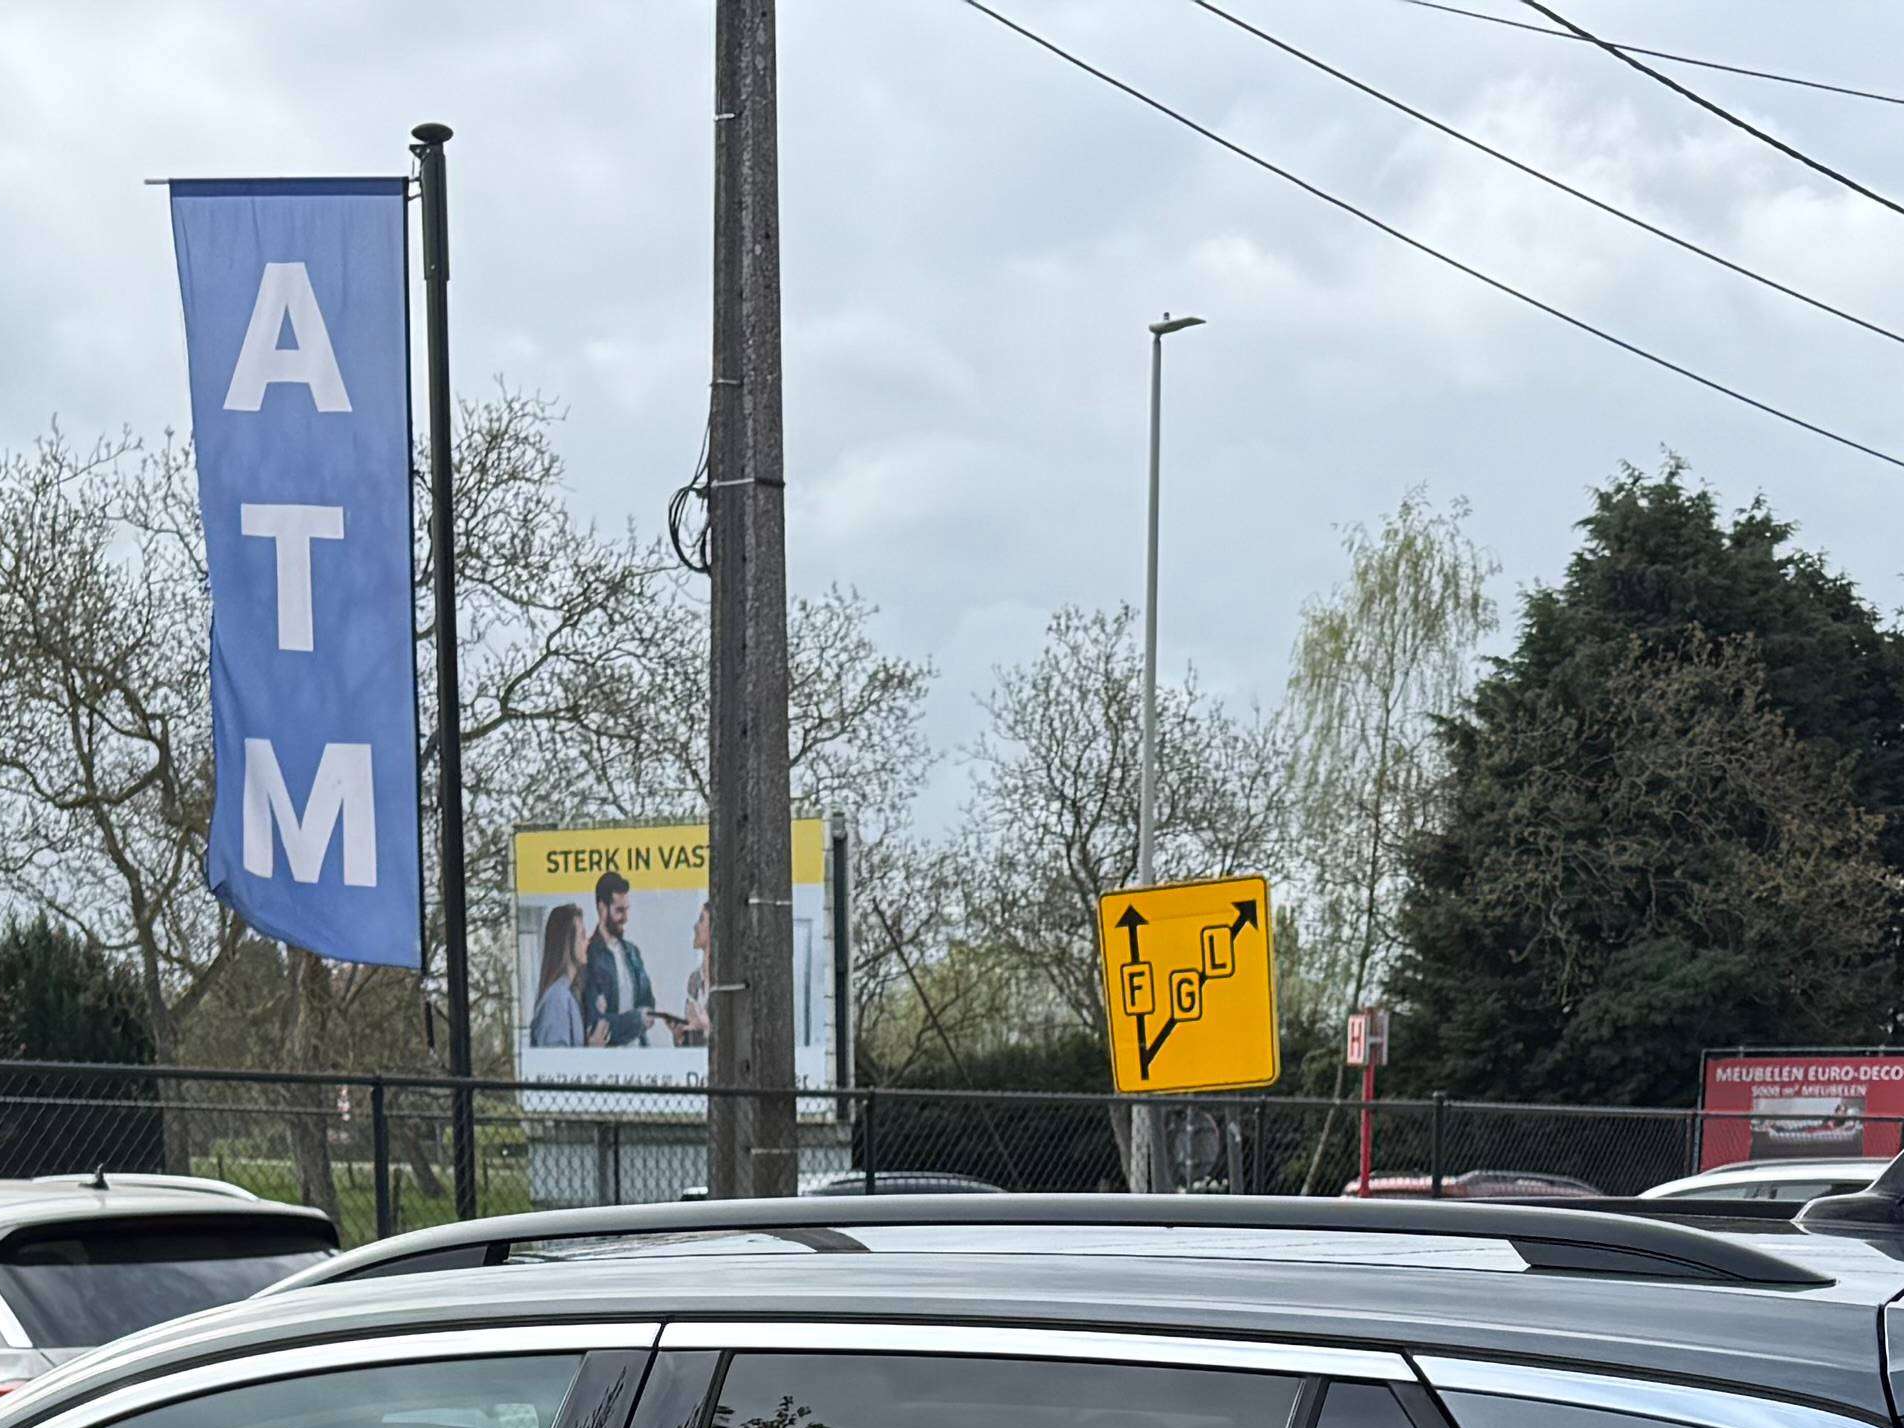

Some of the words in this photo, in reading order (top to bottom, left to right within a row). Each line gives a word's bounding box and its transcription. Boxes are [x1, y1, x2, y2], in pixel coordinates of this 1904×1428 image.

[546, 848, 619, 874] STERK
[627, 848, 650, 871] IN
[1208, 934, 1227, 970] L
[1128, 971, 1145, 1006] F
[1177, 979, 1195, 1012] G
[1716, 1067, 1804, 1082] MEUBELEN
[1808, 1066, 1904, 1080] EURO-DECO
